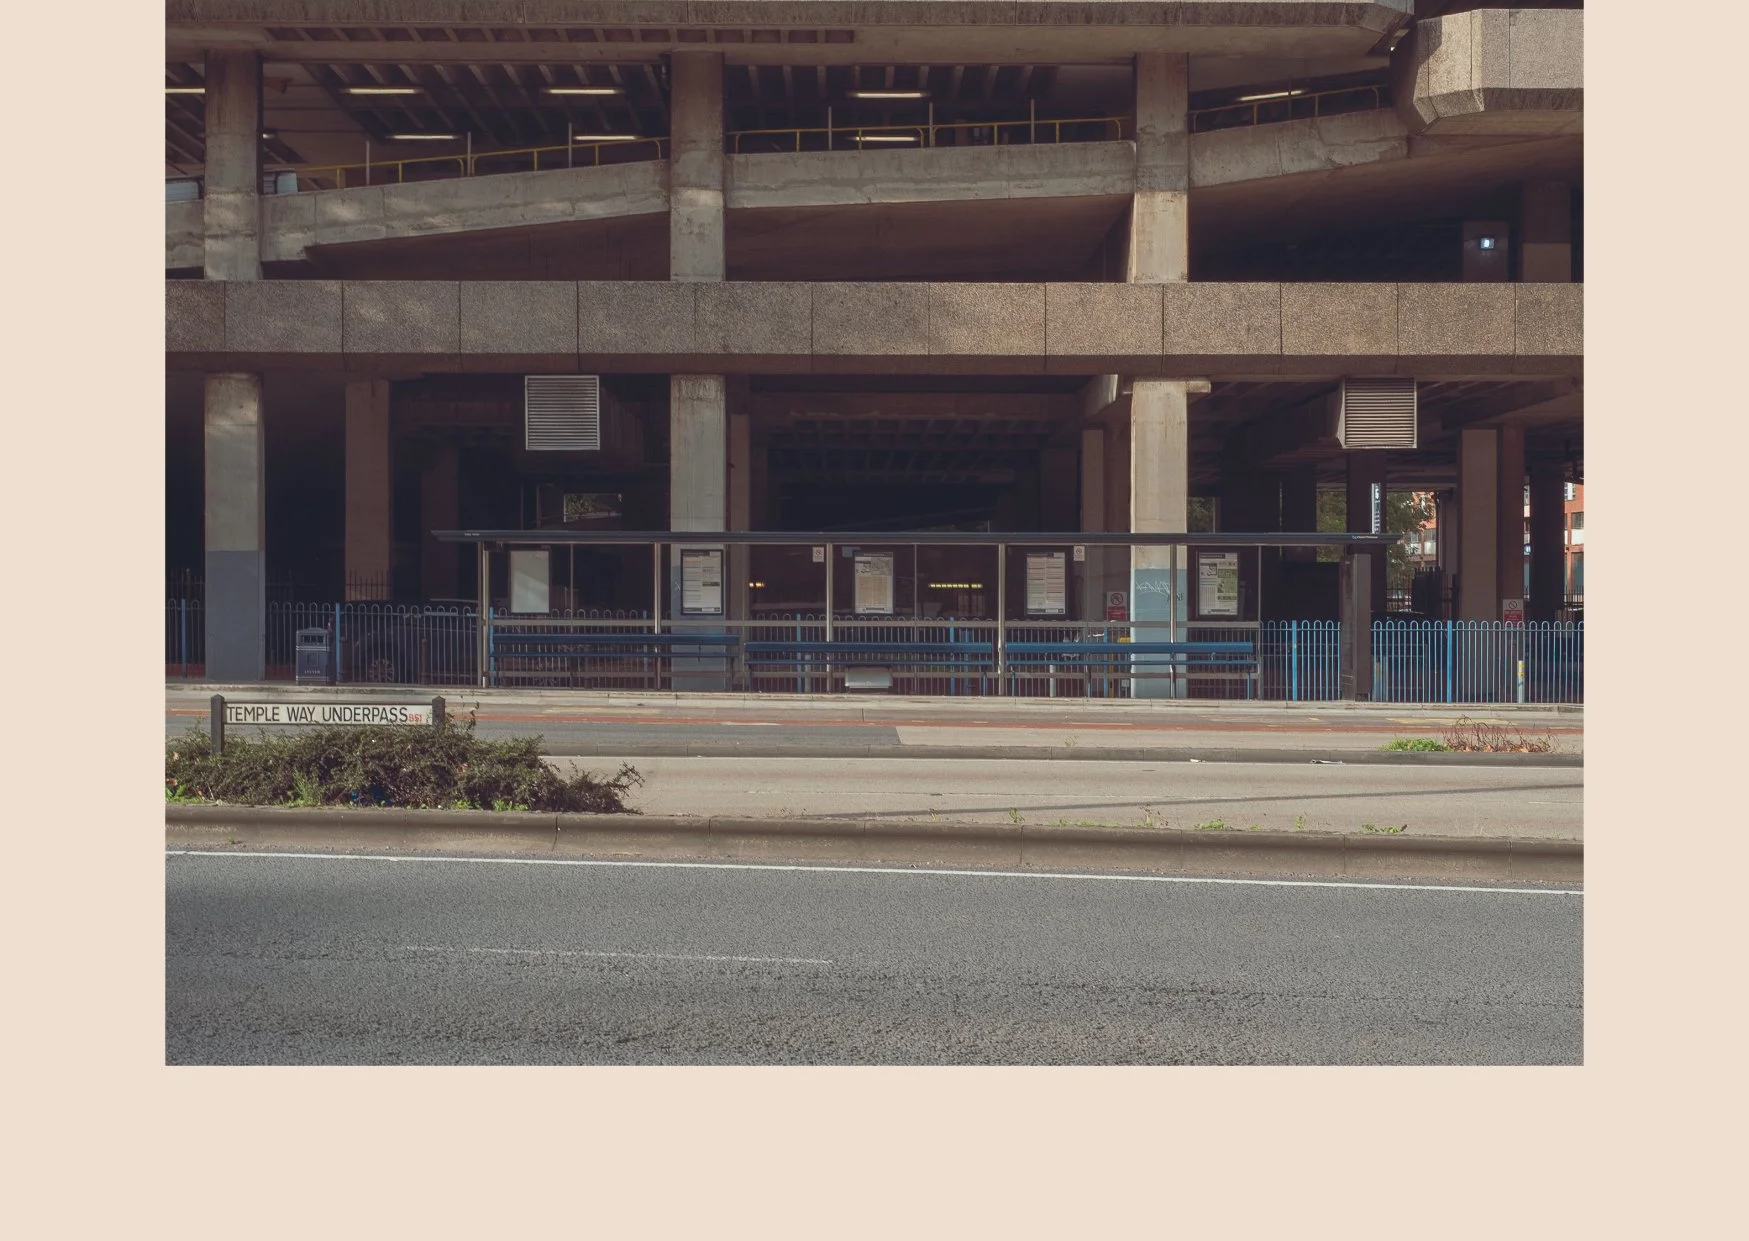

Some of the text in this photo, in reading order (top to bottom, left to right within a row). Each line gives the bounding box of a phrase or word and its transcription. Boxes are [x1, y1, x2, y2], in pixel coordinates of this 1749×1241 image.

[227, 706, 423, 723] TEMPLE WAY UNDERPASS BS1
